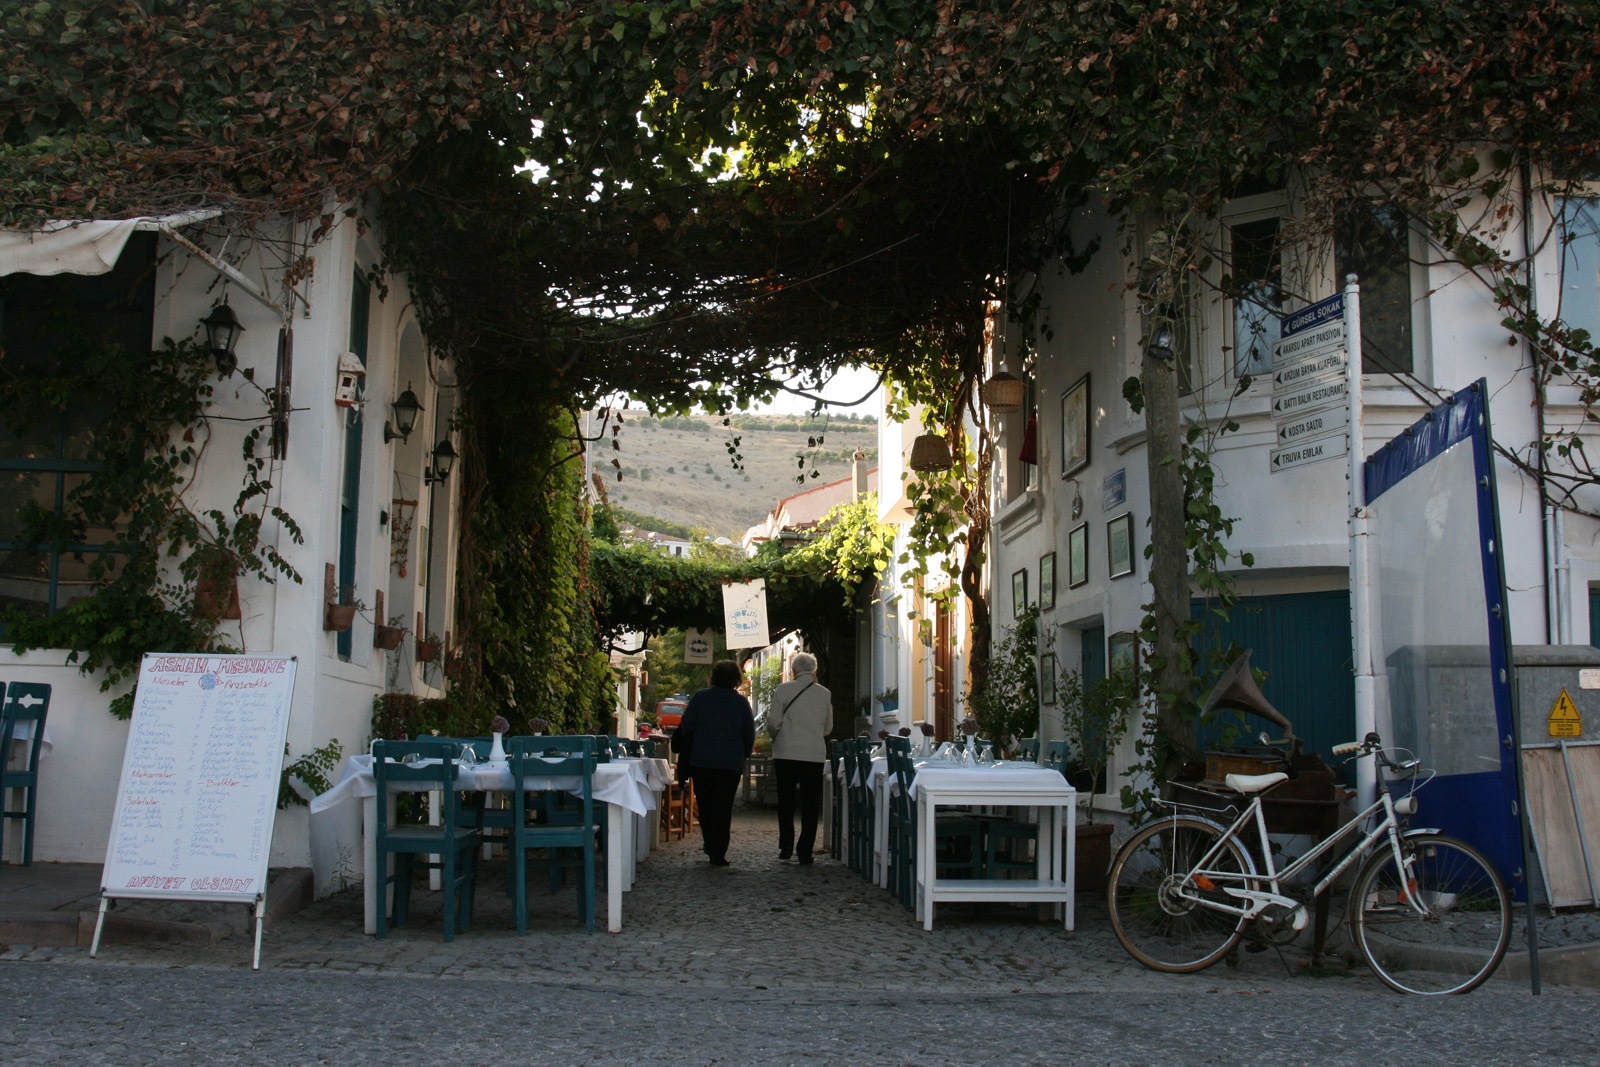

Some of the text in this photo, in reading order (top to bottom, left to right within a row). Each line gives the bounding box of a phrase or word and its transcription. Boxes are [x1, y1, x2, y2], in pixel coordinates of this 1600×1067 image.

[1291, 300, 1341, 330] GÜRSEL SOKAK
[1283, 341, 1300, 355] AKARSU
[1301, 335, 1316, 349] APART
[1284, 368, 1300, 382] ARZUM
[1301, 363, 1317, 376] BAYAN
[1298, 393, 1312, 406] BALIK
[1312, 384, 1344, 400] RESTAURANT
[1288, 418, 1323, 437] KOSTA SALTO
[1282, 445, 1324, 464] TRUVA EMLAK
